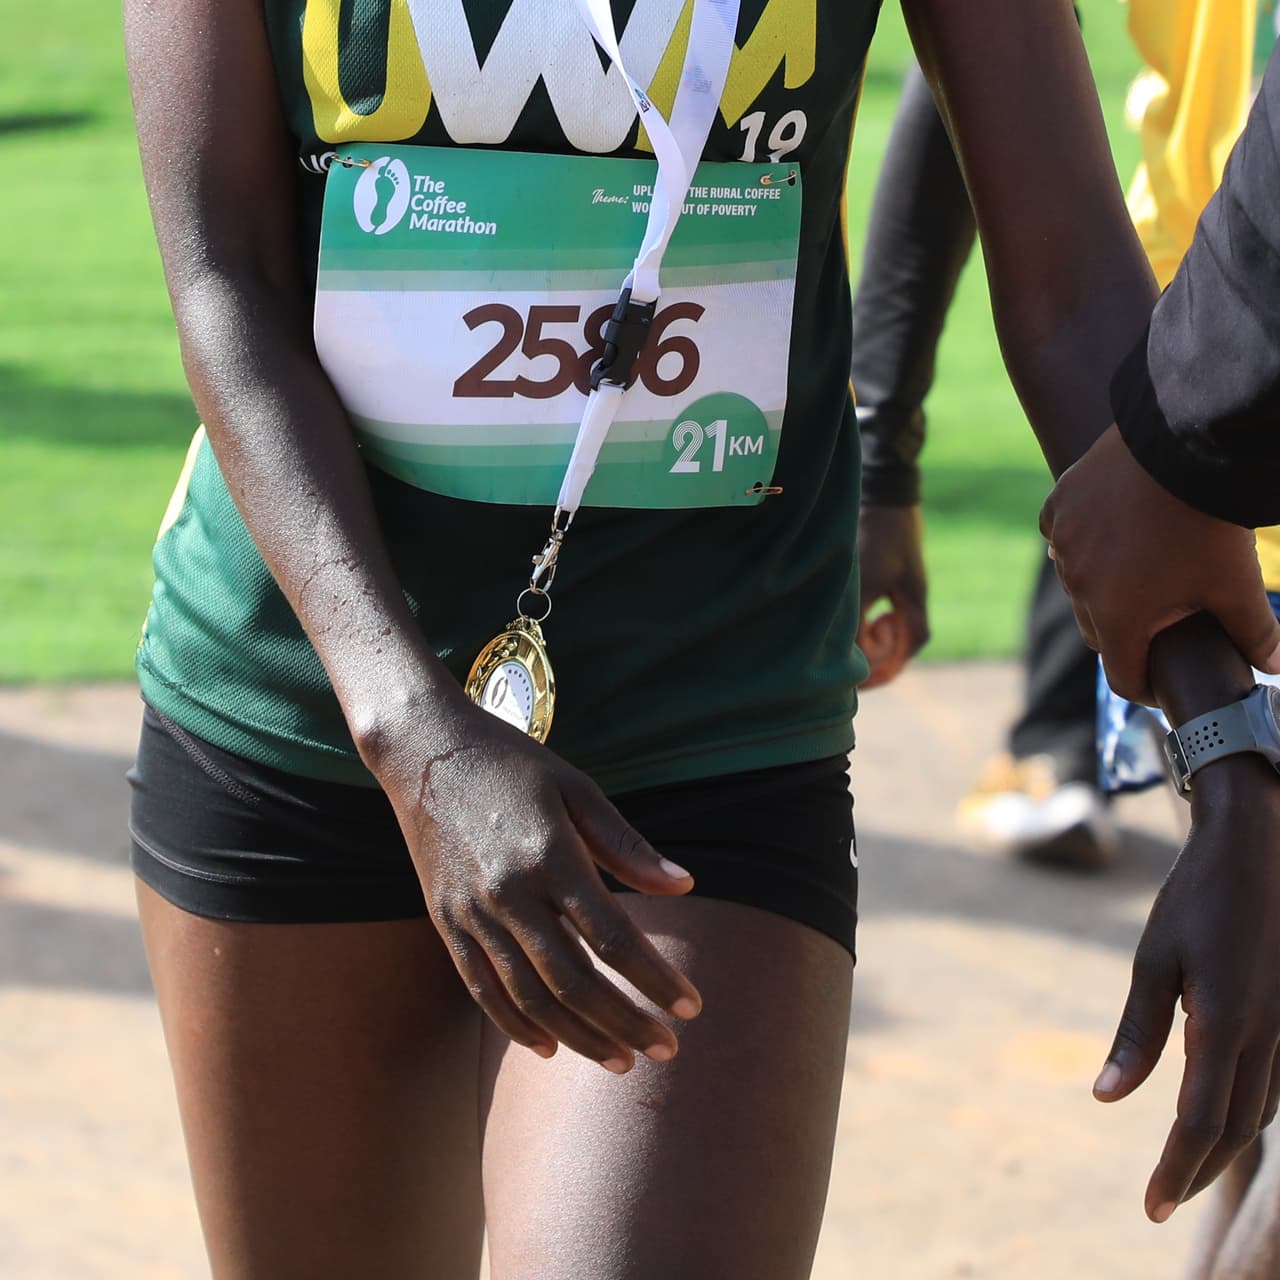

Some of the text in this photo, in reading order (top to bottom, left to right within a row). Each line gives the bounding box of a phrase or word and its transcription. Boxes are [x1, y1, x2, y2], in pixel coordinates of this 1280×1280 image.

[737, 109, 808, 164] 19
[413, 175, 445, 193] The
[688, 186, 782, 200] THE RURAL COFFEE
[410, 194, 467, 215] Coffee
[591, 188, 629, 204] Theme:
[681, 203, 757, 217] UT OF POVERTY
[409, 212, 497, 235] Marathon
